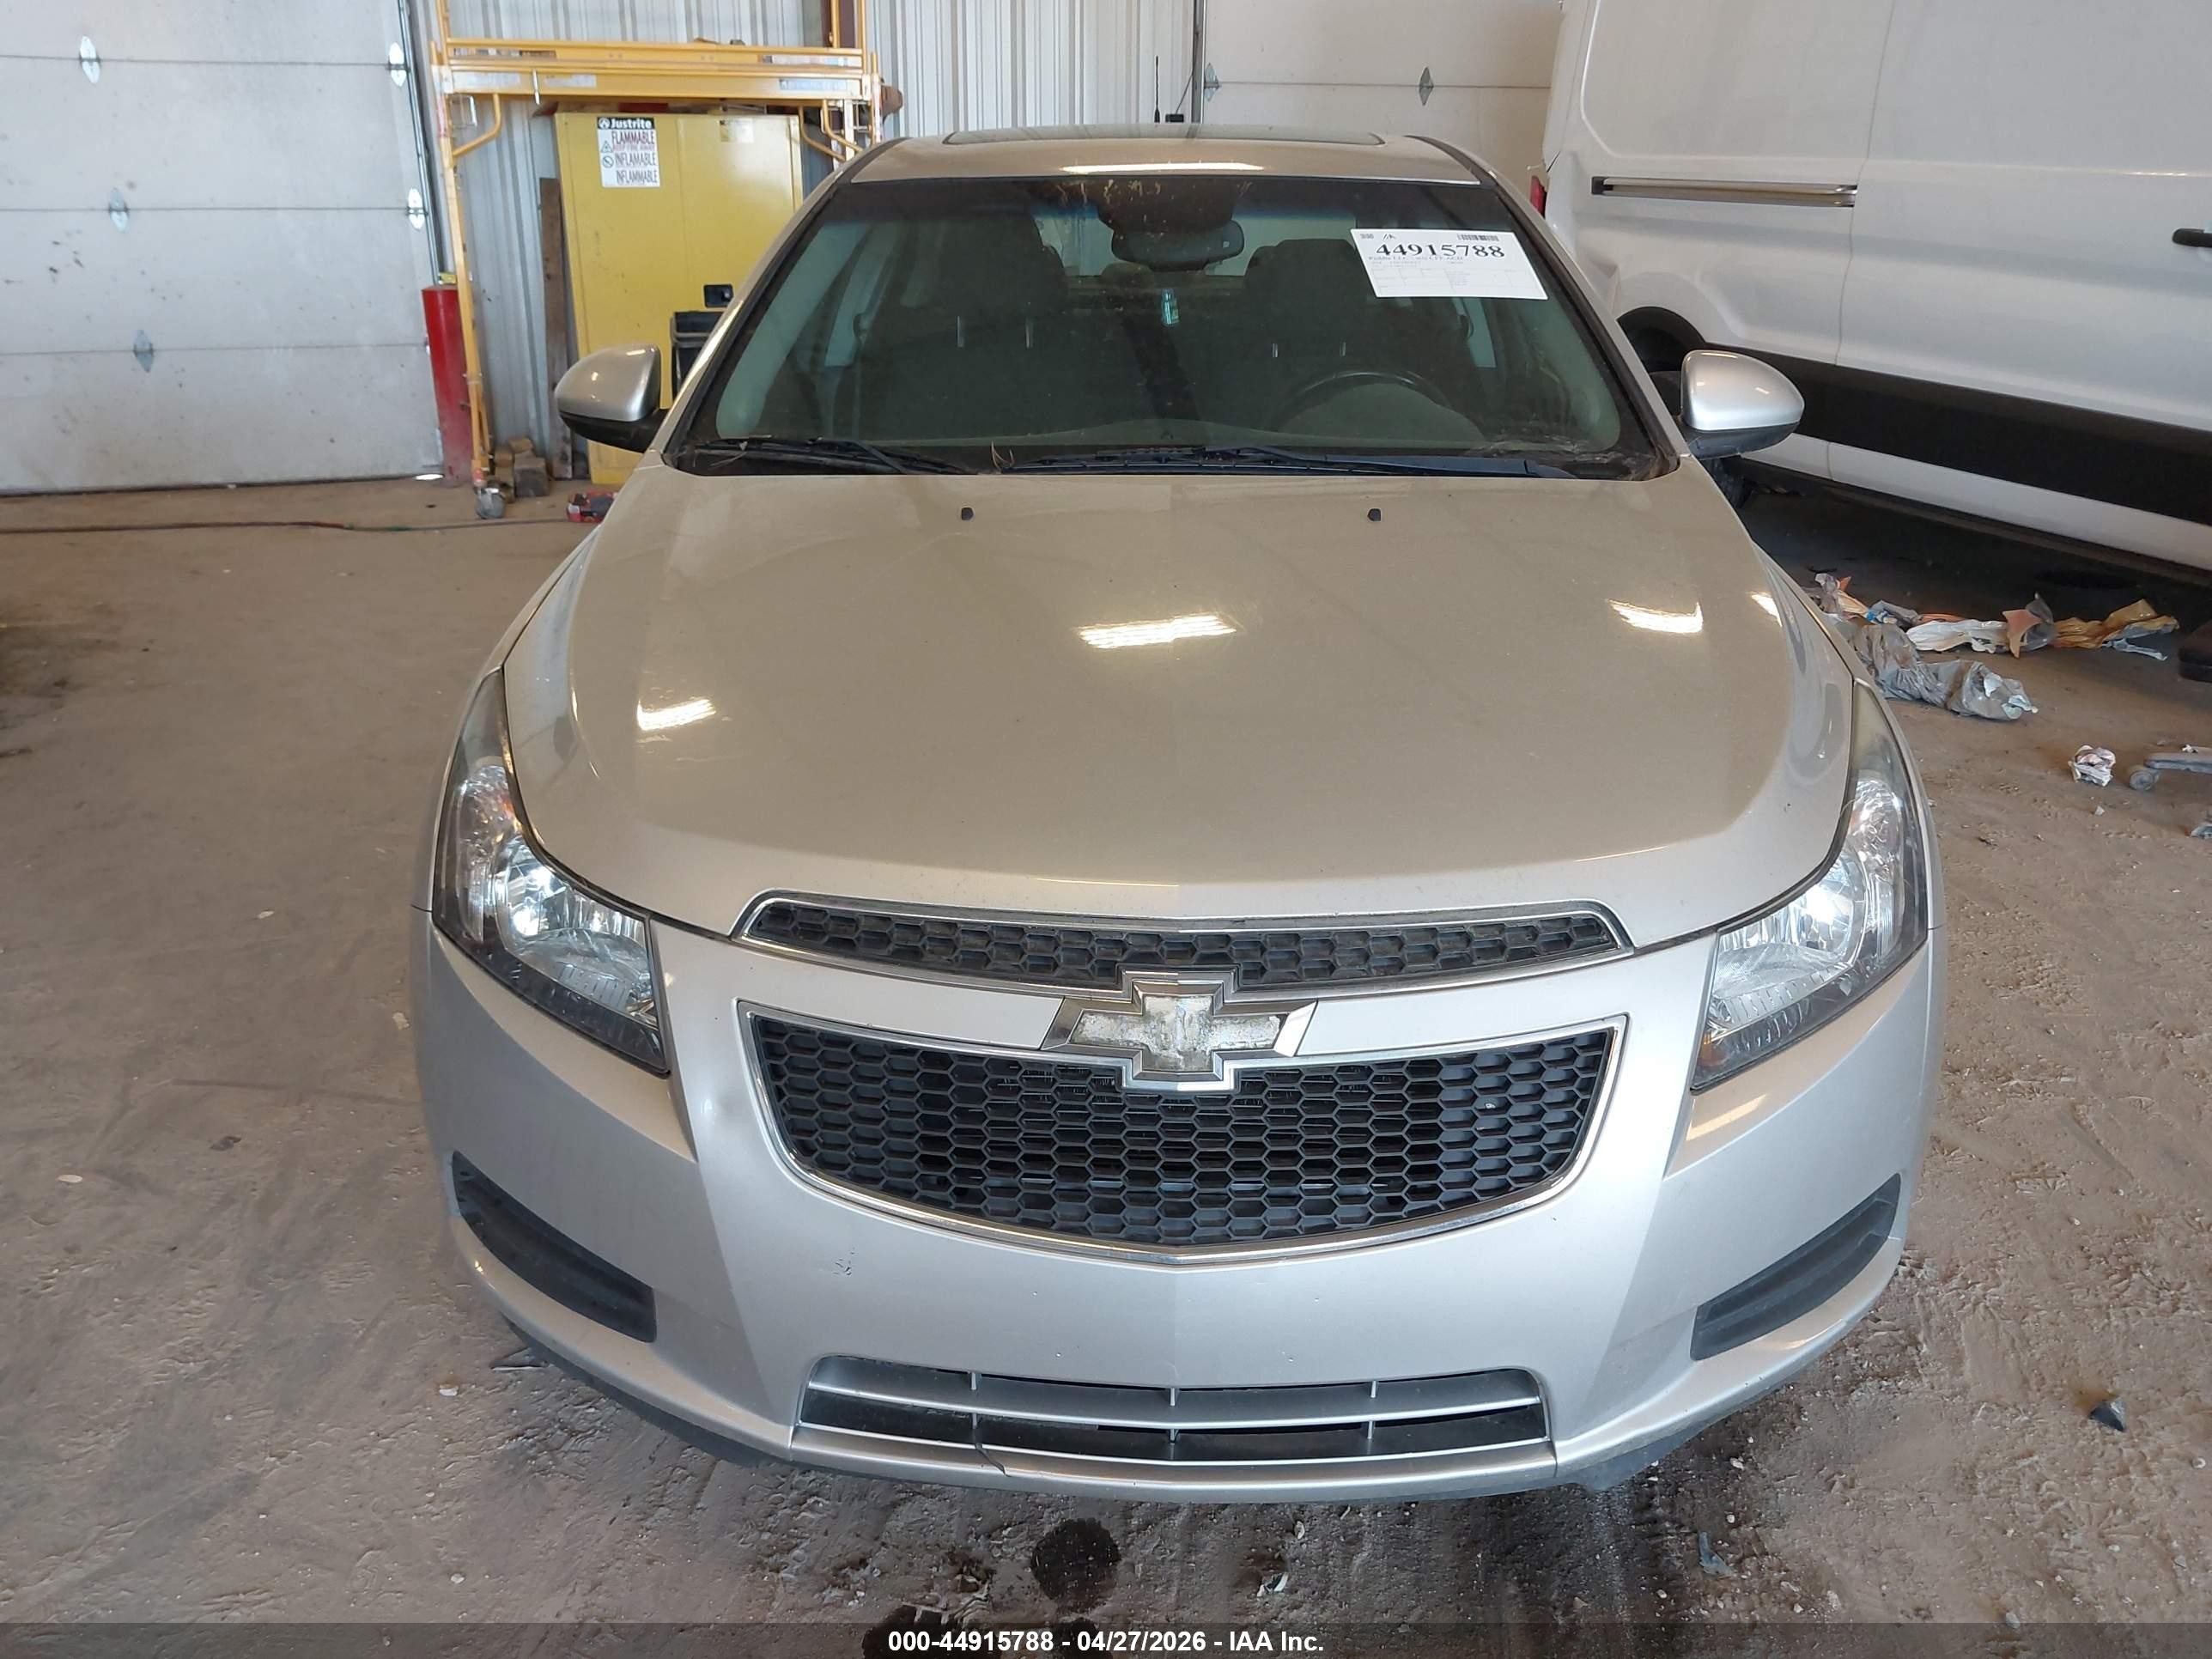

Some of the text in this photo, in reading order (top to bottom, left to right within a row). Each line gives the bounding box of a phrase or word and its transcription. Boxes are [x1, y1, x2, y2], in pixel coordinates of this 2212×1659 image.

[611, 118, 653, 129] Justrite
[611, 131, 655, 145] FLAMMABLE
[1376, 243, 1505, 258] 44915788
